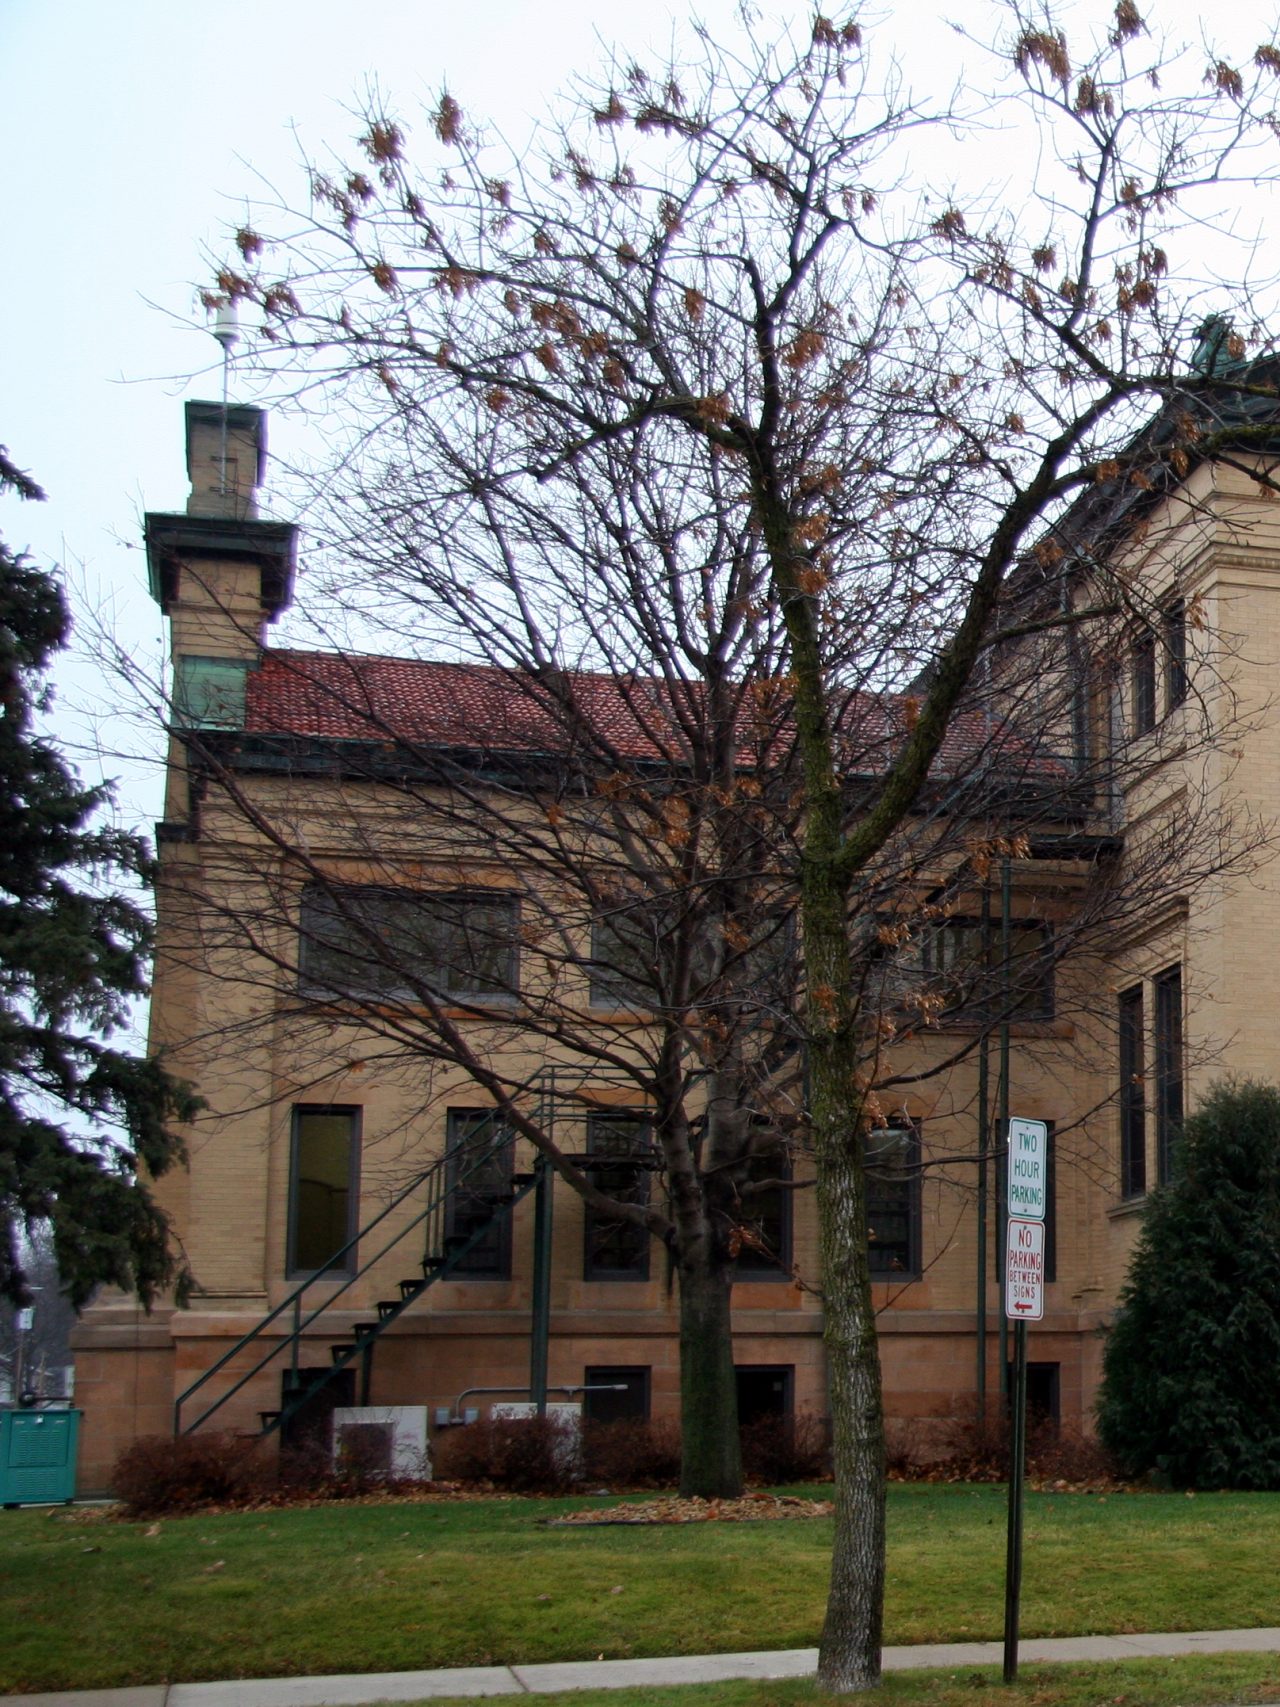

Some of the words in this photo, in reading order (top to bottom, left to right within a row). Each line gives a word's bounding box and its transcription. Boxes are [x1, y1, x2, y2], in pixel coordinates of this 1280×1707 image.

[1018, 1132, 1037, 1153] TWO
[1014, 1158, 1040, 1180] HOUR
[1011, 1184, 1042, 1206] PARKING
[1018, 1228, 1033, 1248] NO
[1009, 1249, 1041, 1270] PARKING
[1009, 1270, 1041, 1285] BETWEEN
[1013, 1285, 1036, 1299] SIGNS
